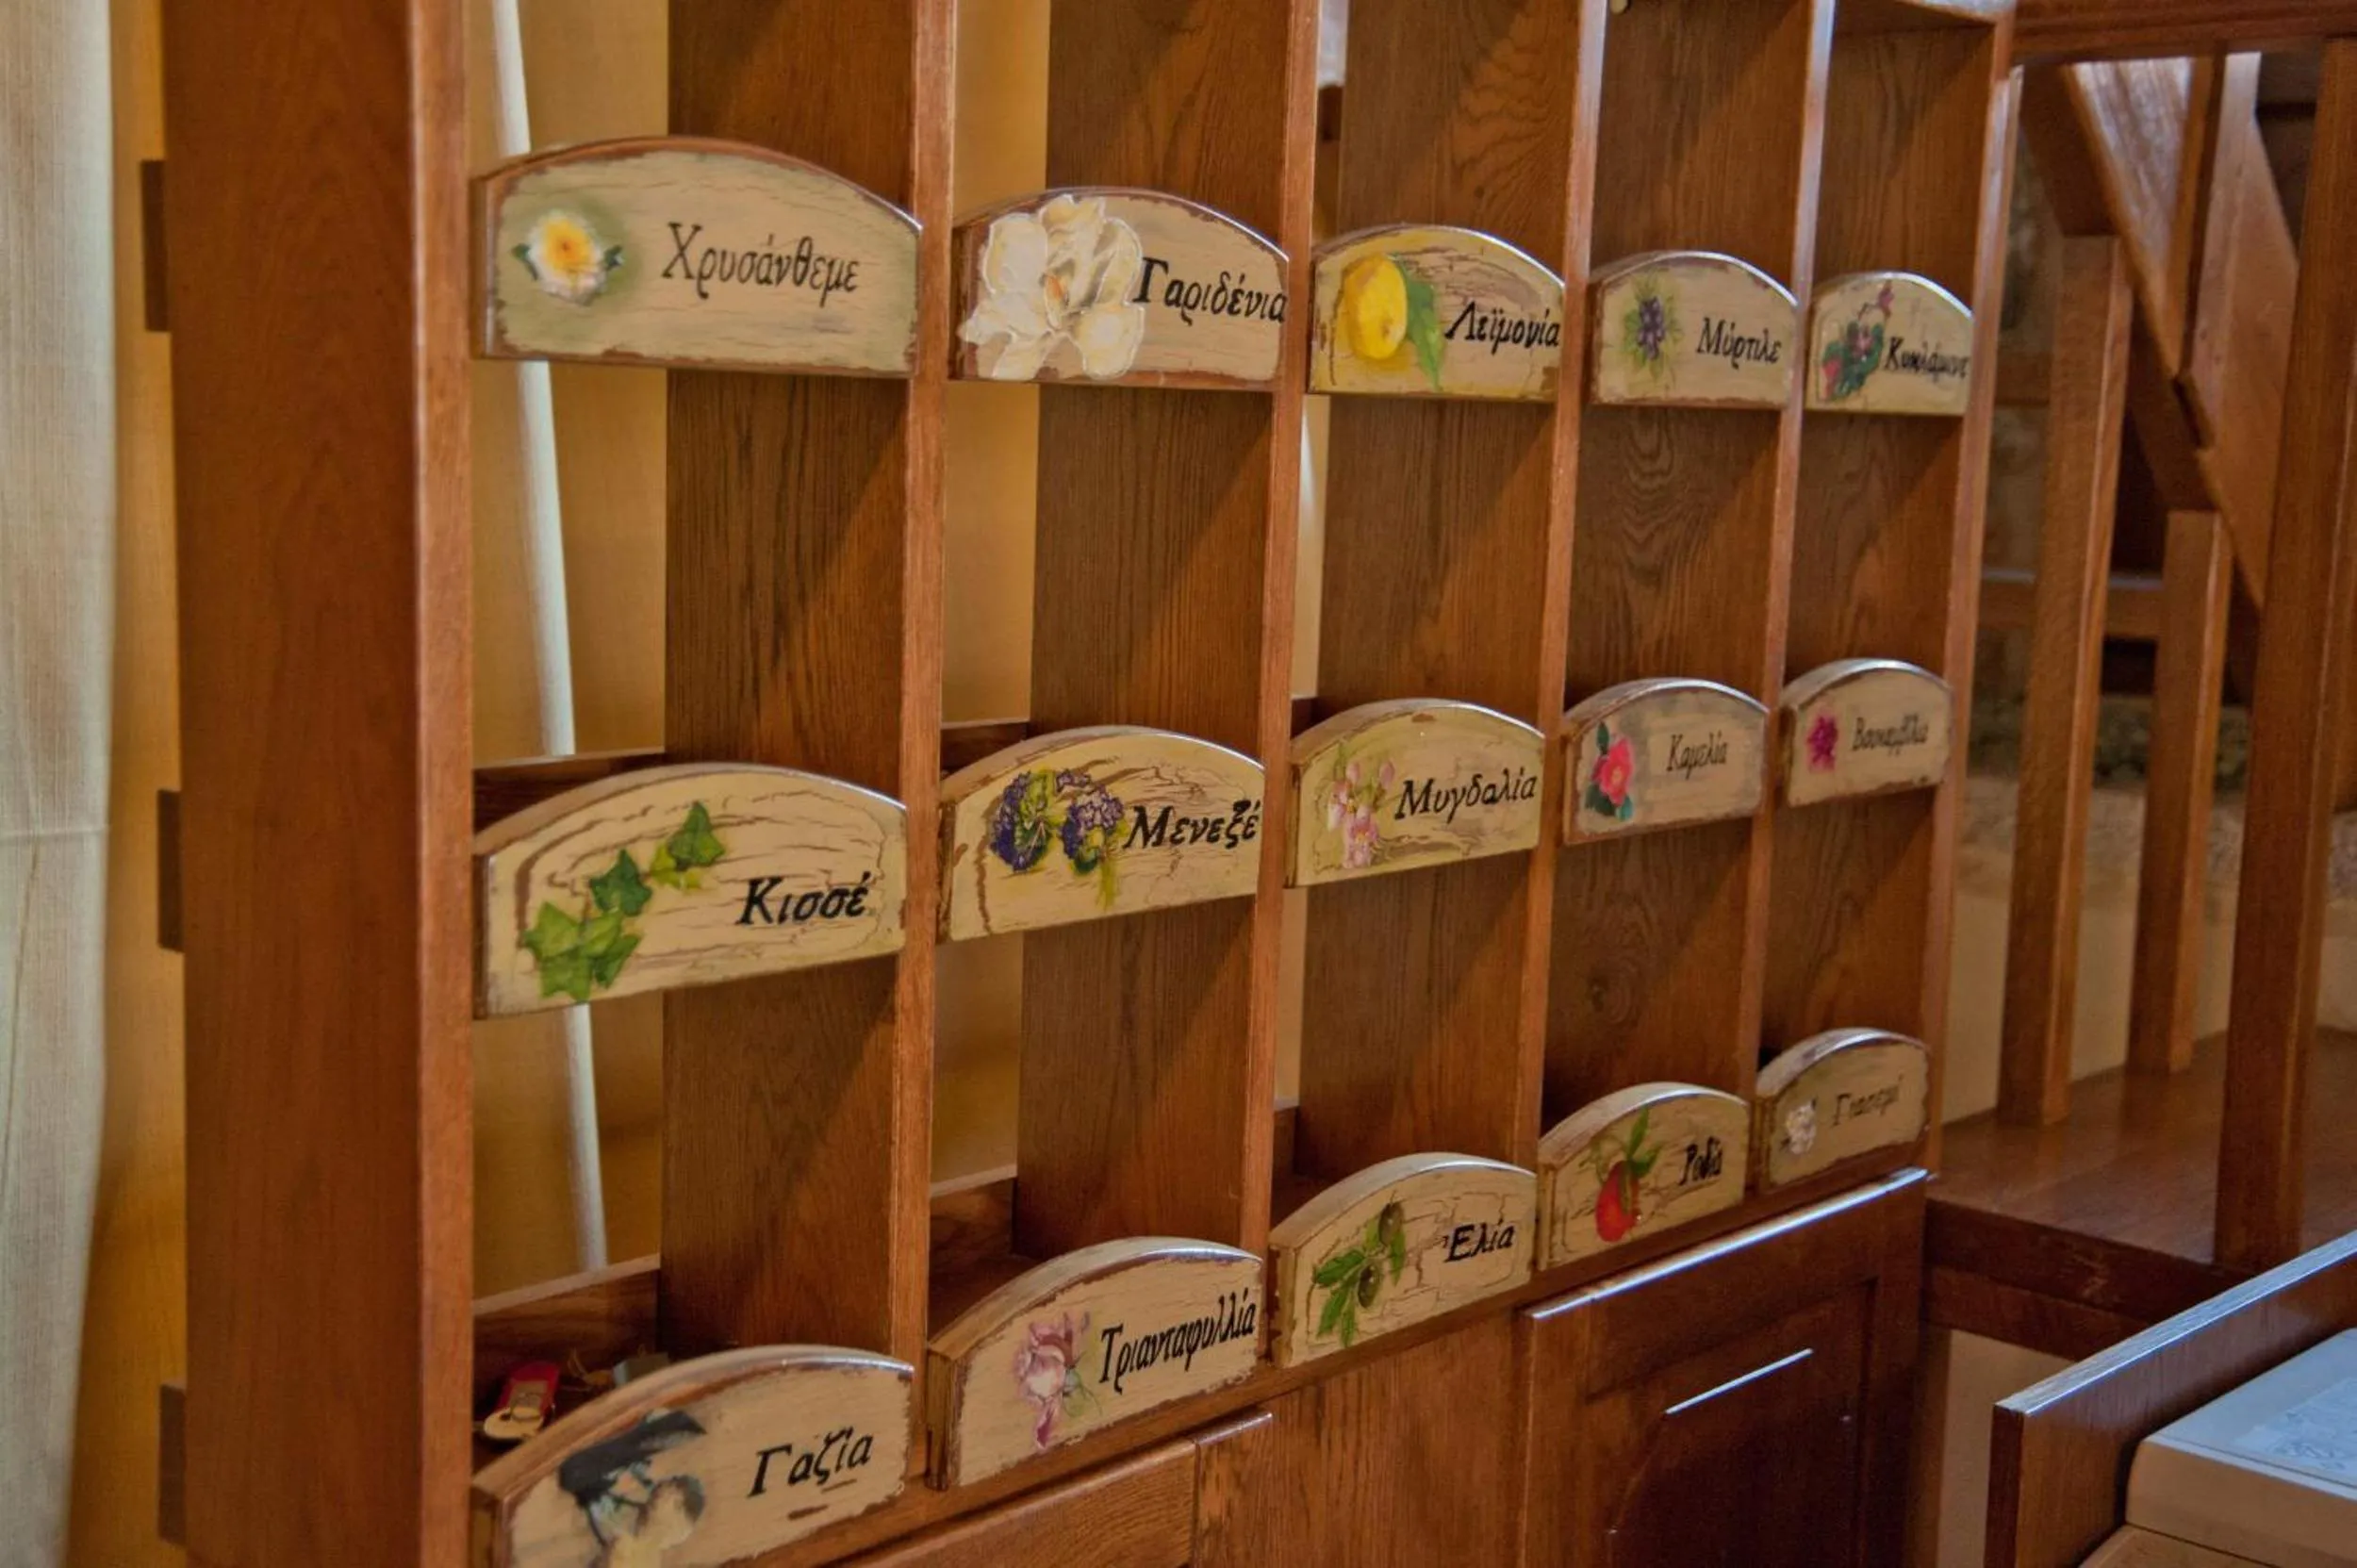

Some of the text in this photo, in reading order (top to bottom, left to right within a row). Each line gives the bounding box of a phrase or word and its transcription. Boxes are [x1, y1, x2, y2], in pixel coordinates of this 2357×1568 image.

[661, 222, 860, 307] Χρυσάνθεμε
[1121, 799, 1261, 850] Μενεξέ
[1393, 767, 1539, 824] Μυγδαλία
[735, 871, 872, 927] Κισσέ
[1098, 1286, 1258, 1395] Τριανταφυλλία
[748, 1425, 874, 1498] Γαζία
